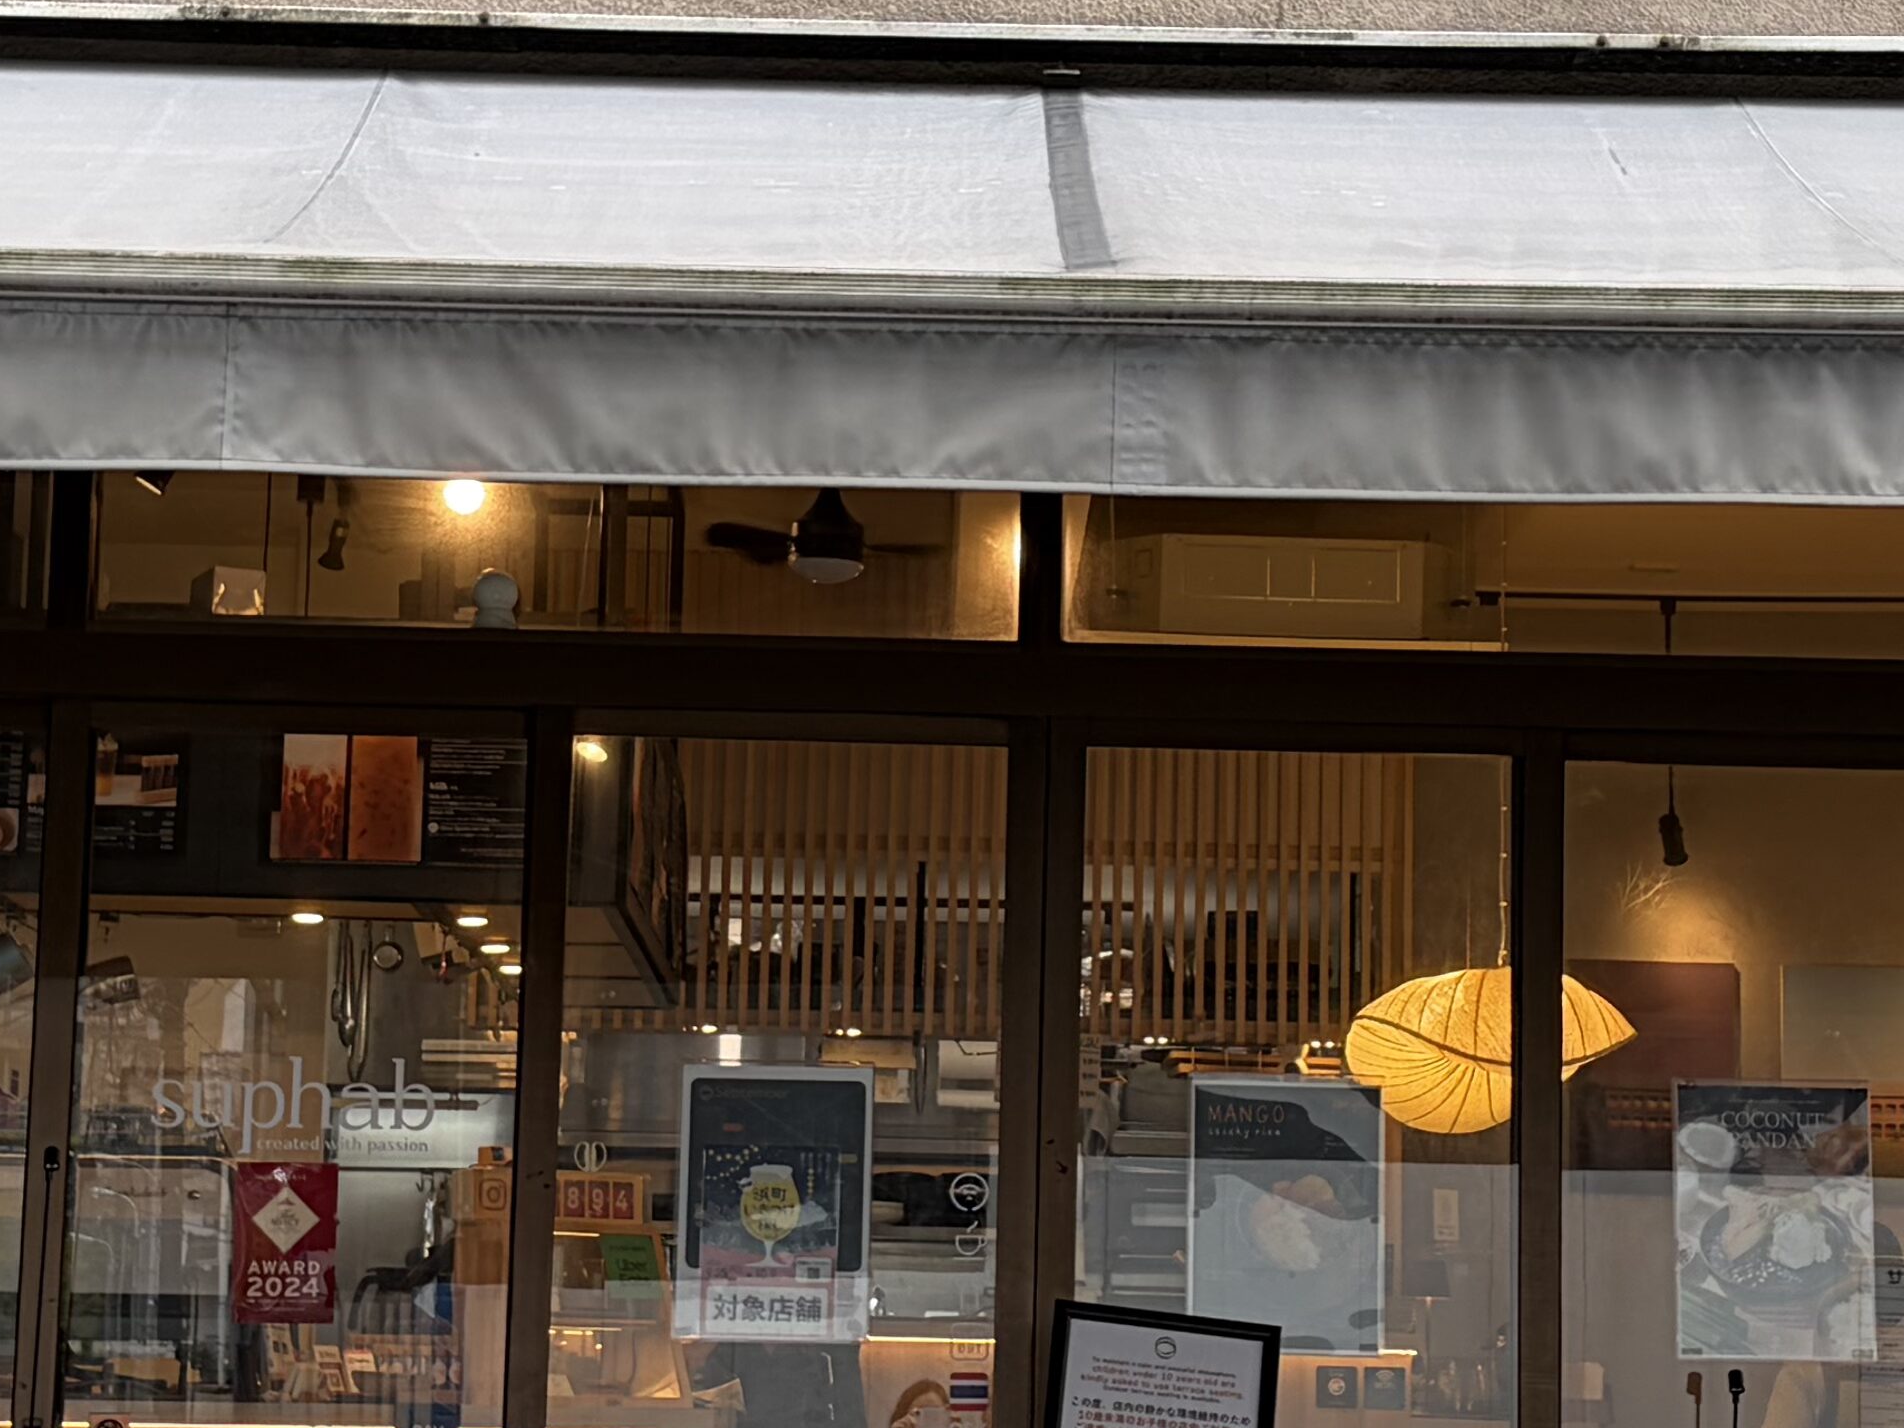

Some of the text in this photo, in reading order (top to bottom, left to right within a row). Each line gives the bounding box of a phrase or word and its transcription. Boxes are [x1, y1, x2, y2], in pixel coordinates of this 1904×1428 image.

[150, 1056, 436, 1155] suphab
[1207, 1103, 1286, 1123] MANGO
[1719, 1110, 1826, 1130] COCONUT
[257, 1136, 429, 1155] created with passion
[247, 1260, 321, 1275] AWARD
[246, 1276, 320, 1297] 2024
[712, 1294, 823, 1323] 対象店舗
[1081, 1374, 1109, 1386] kindly
[1111, 1376, 1139, 1387] asked
[1141, 1379, 1151, 1388] to
[1153, 1382, 1170, 1390] use
[1172, 1382, 1205, 1394] terrace
[1092, 1365, 1236, 1388] children under 10 years old are
